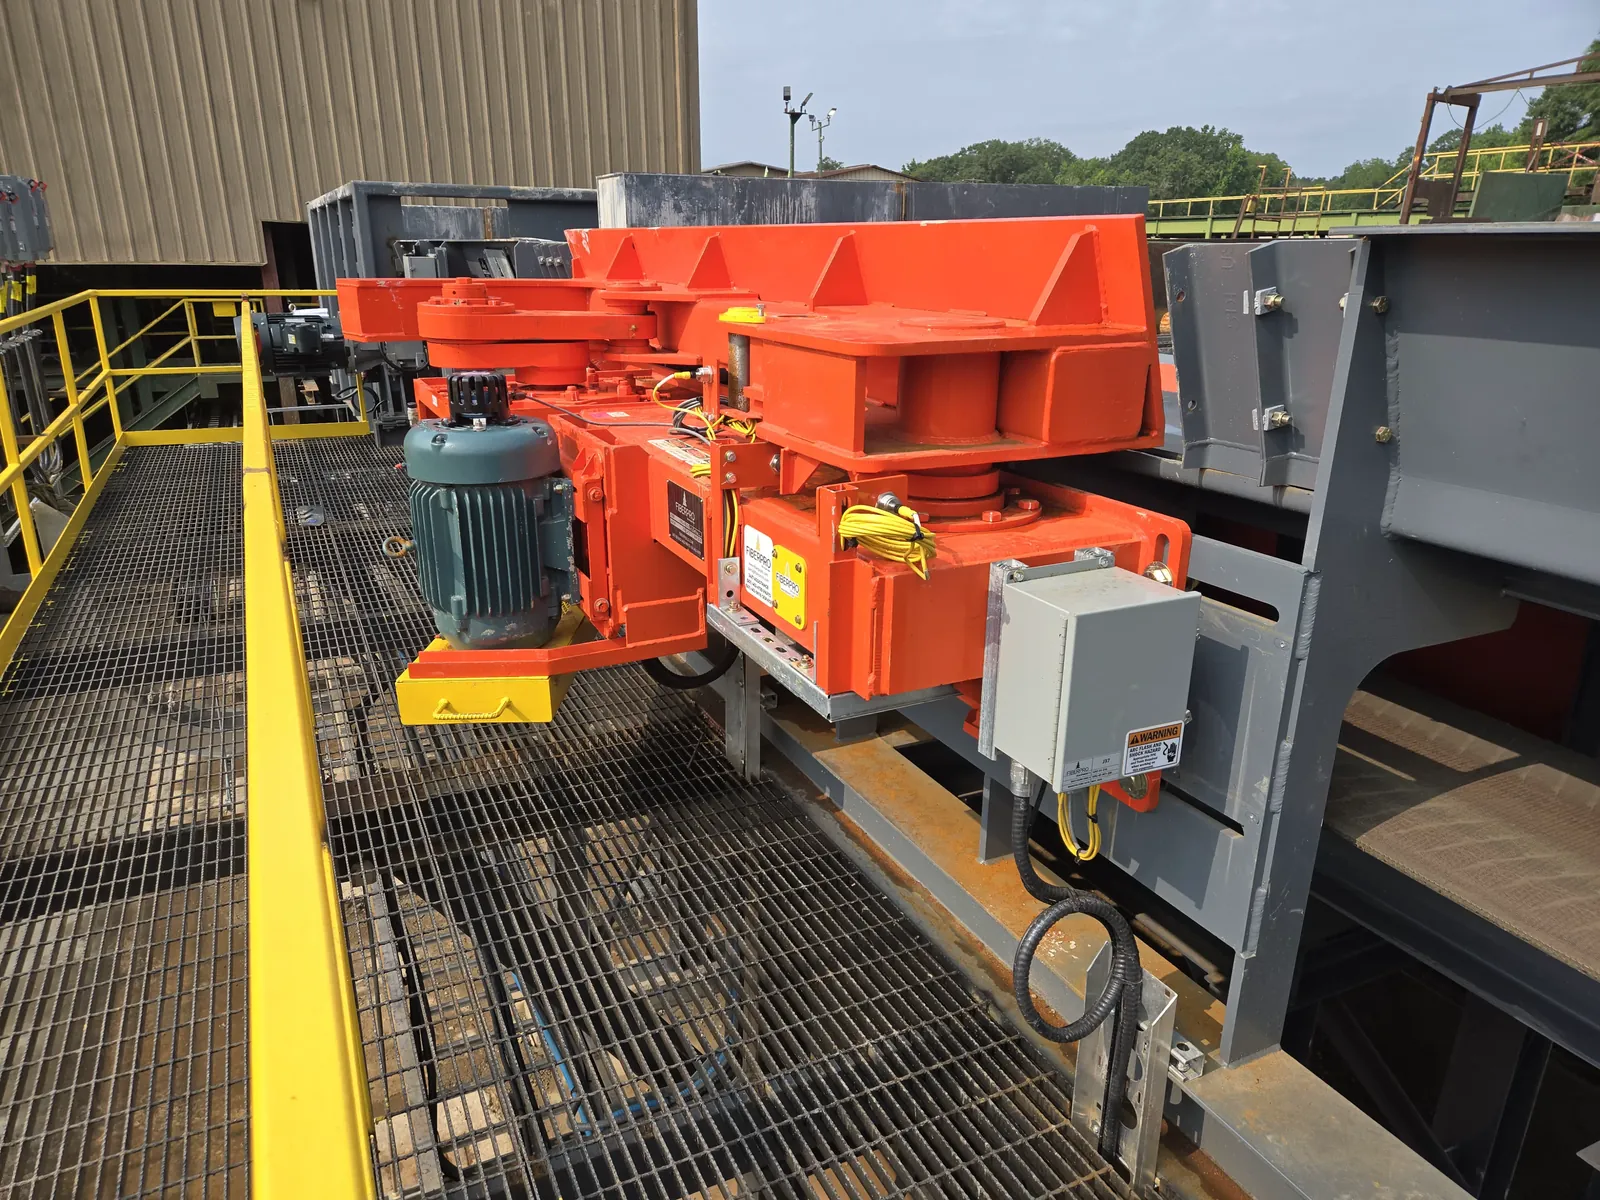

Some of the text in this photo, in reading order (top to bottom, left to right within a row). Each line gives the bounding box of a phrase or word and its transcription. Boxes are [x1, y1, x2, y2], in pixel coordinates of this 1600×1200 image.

[675, 502, 696, 520] FIBERPRO
[746, 546, 771, 568] FIBERPRO
[776, 572, 799, 593] FIBERPRO
[1140, 726, 1178, 742] WARNING
[1067, 767, 1089, 776] FIBERPRO
